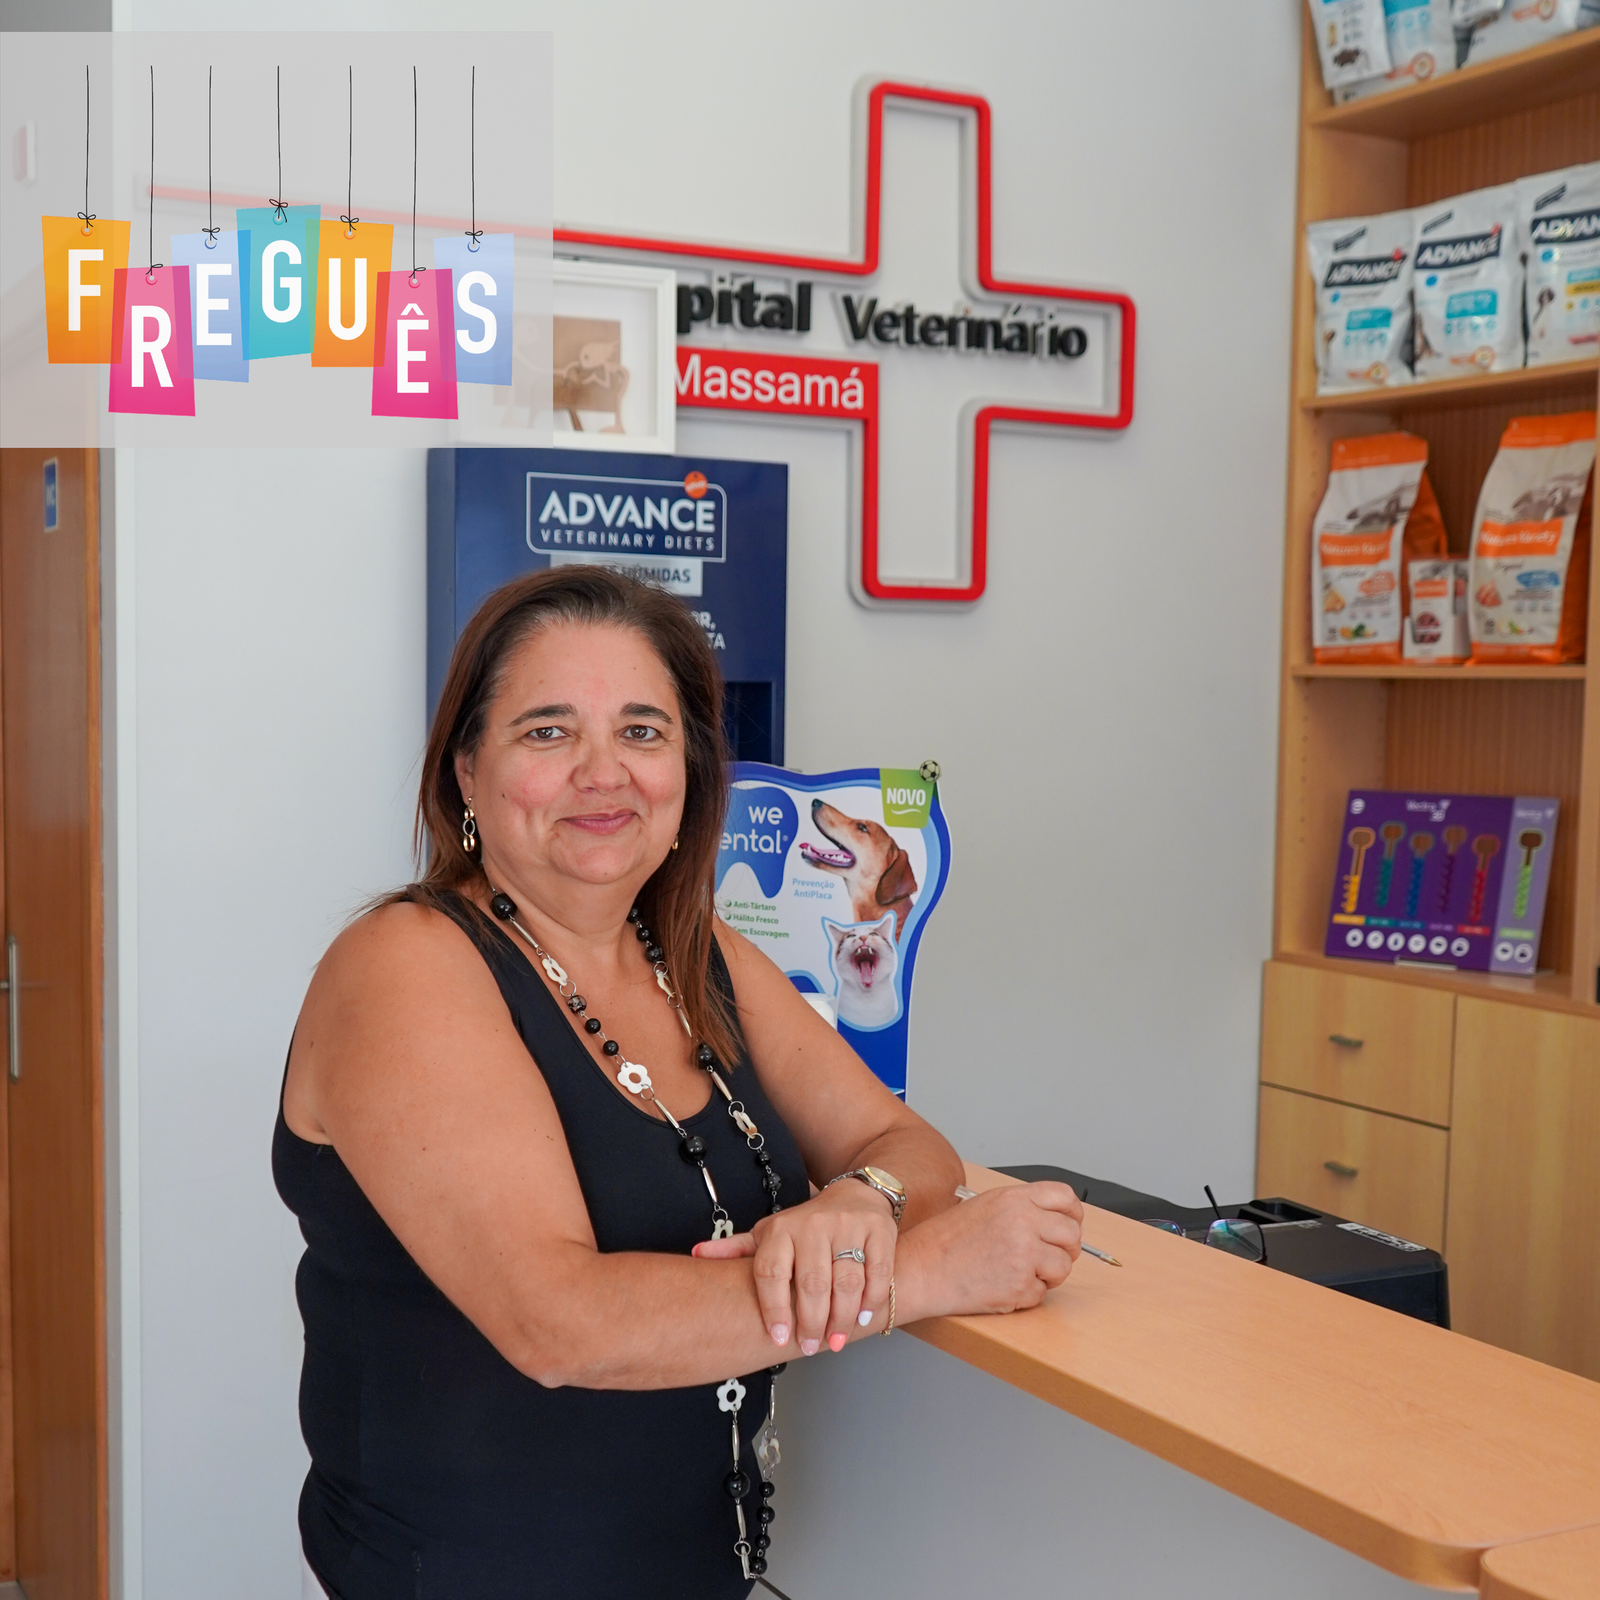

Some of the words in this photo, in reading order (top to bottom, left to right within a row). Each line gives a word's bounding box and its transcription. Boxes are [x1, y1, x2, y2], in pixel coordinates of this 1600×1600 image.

[1417, 237, 1499, 267] ADVANCE
[841, 294, 1088, 359] Veterinário
[676, 352, 865, 410] Massamá
[538, 490, 716, 534] ADVANCE
[540, 528, 656, 548] VETERINARY
[664, 535, 716, 552] DIETS
[886, 787, 927, 807] NOVO
[748, 805, 784, 825] we
[792, 878, 835, 890] Prevenção
[793, 890, 833, 901] AntiPlaca
[733, 900, 777, 912] Anti-Tártaro
[733, 912, 755, 923] Hálito
[756, 915, 780, 925] Fresco
[749, 927, 790, 940] Escovagem
